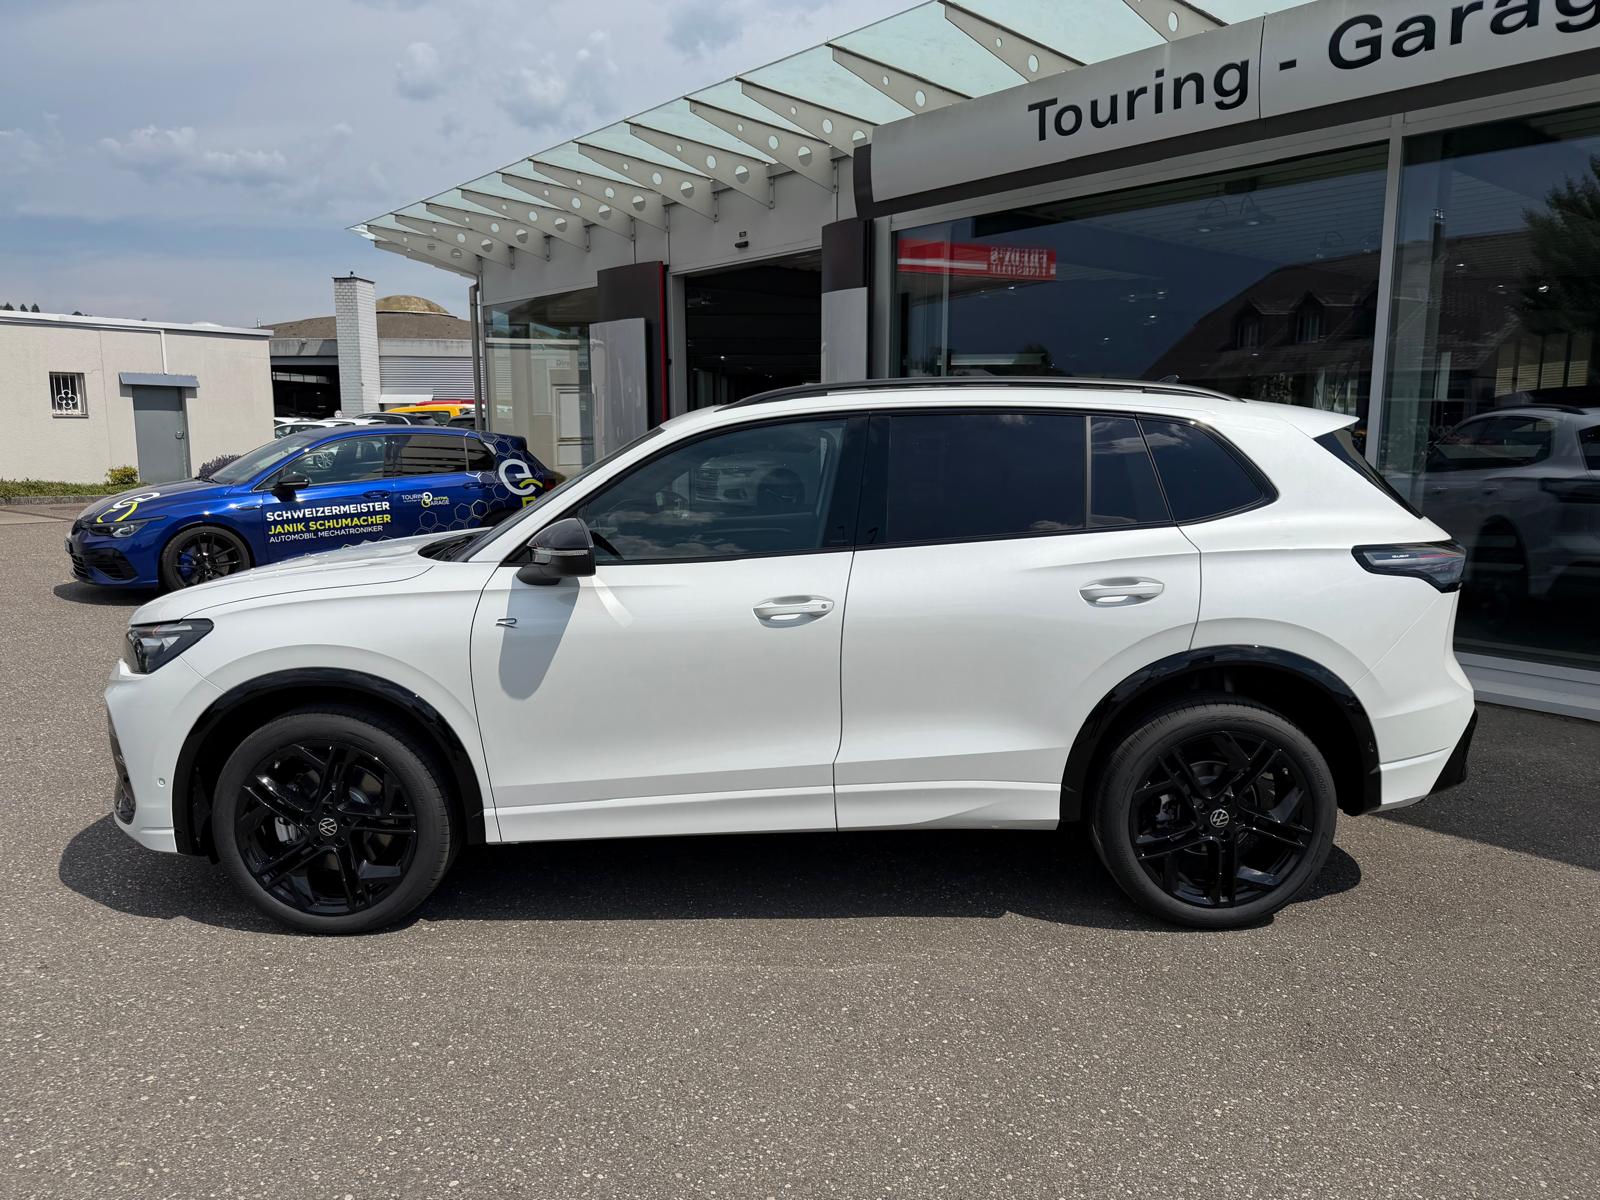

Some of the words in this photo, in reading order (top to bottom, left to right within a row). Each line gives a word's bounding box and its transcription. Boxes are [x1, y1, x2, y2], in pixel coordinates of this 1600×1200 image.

[1027, 58, 1249, 141] Touring
[266, 501, 391, 522] SCHWEIZERMEISTER
[268, 522, 306, 535] JANIK
[309, 514, 392, 531] SCHUMACHER
[269, 533, 317, 543] AUTOMOBIL
[318, 525, 384, 538] MECHATRONIKER
